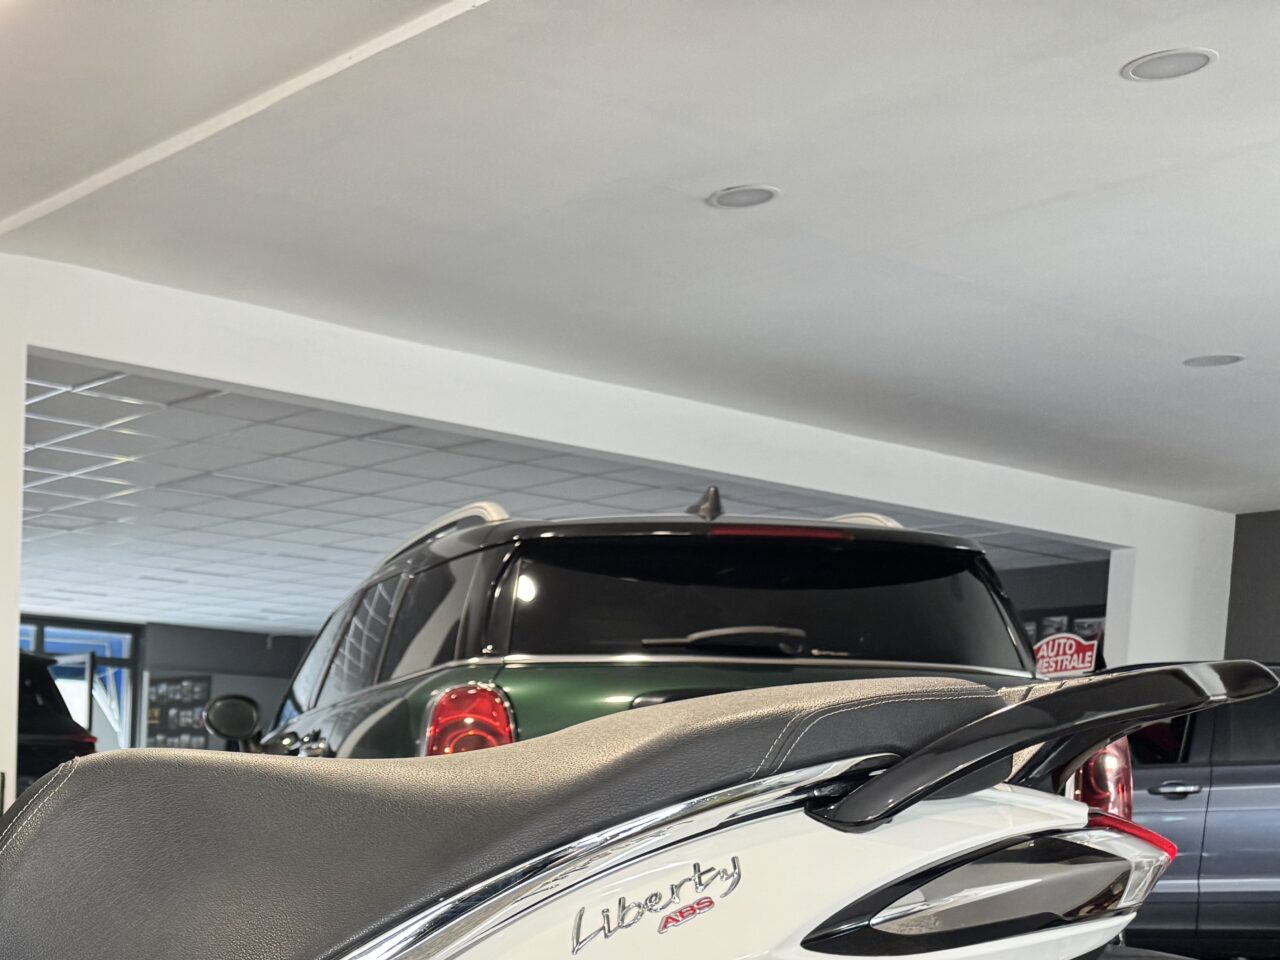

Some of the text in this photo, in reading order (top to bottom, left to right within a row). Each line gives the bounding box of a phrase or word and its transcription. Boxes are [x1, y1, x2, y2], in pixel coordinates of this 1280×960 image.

[1037, 639, 1076, 658] AUTO
[572, 856, 741, 955] Liberty
[658, 897, 715, 934] ABS
